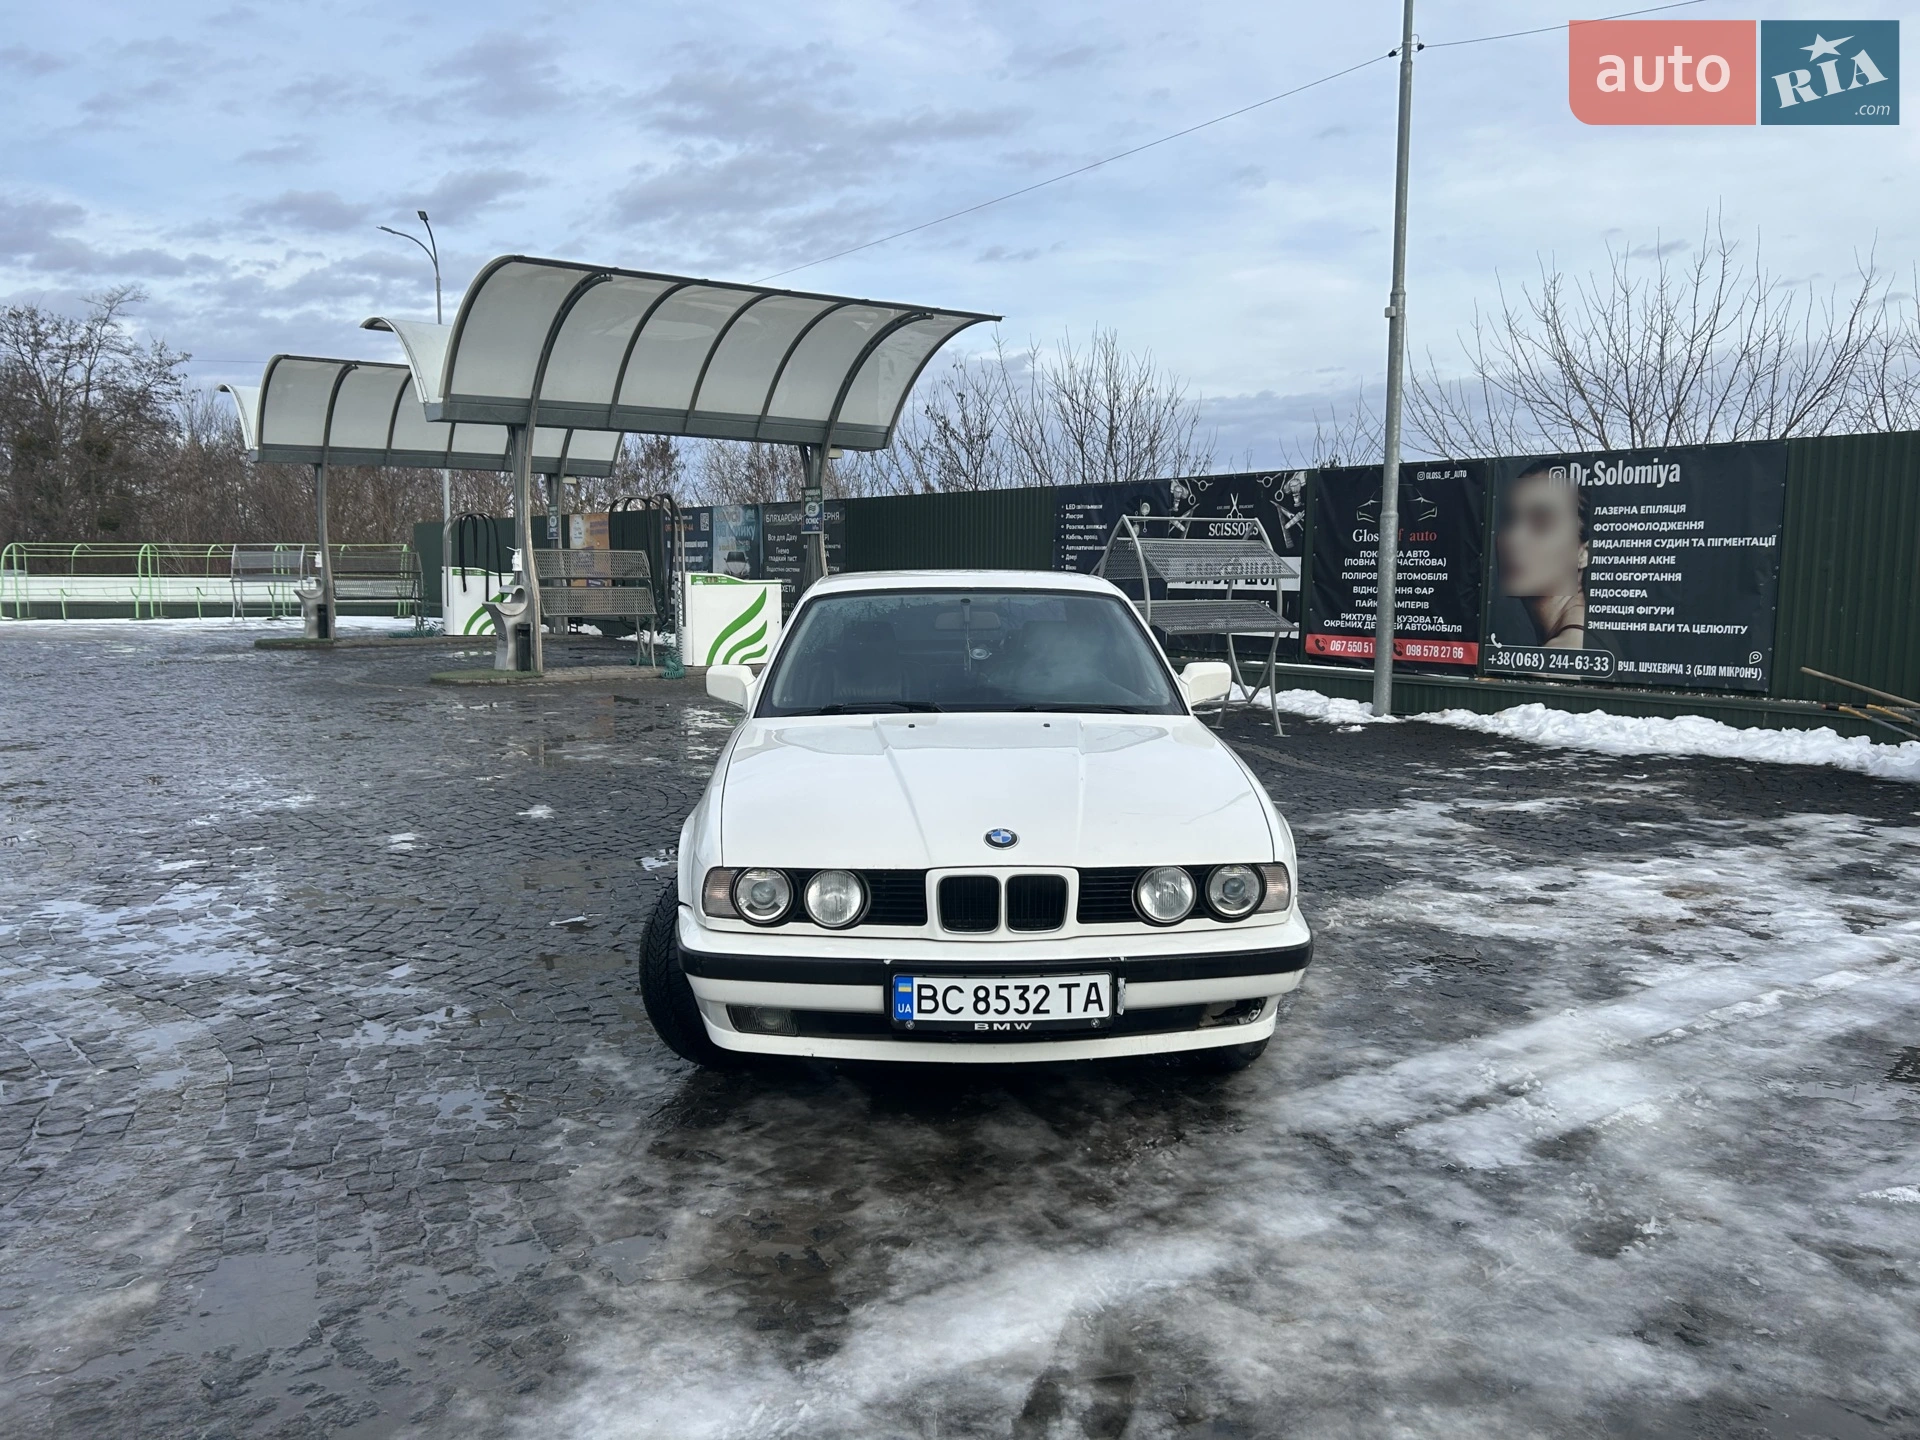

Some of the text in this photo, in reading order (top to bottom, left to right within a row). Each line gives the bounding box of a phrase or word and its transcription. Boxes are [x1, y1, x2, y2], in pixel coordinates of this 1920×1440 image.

[1569, 458, 1681, 488] Dr.Solomiya
[1594, 504, 1686, 516] ЛАЗЕРНА ЕПІЛЯЦІЯ
[1593, 520, 1705, 532] ФОТООМОЛОДЖЕННЯ
[1352, 529, 1380, 543] Glos
[1409, 530, 1438, 541] auto
[1592, 534, 1777, 549] ВИДАЛЕННЯ СУДИН ТА ПІГМЕНТАЦІЇ
[1405, 550, 1430, 558] АВТО
[1591, 555, 1676, 565] ЛІКУВАННЯ АКНЕ
[1344, 557, 1447, 567] (ПОВНА ЧАСТКОВА)
[1396, 572, 1449, 581] ВТОМОБІЛЯ
[1590, 572, 1682, 582] ВІСКІ ОБГОРТАННЯ
[1414, 586, 1435, 595] ФАР
[1590, 588, 1648, 599] ЕНДОСФЕРА
[1588, 604, 1675, 616] КОРЕКЦІЯ ФІГУРИ
[1396, 615, 1432, 624] КУЗОВА
[1432, 616, 1444, 624] ТА
[1323, 620, 1363, 629] ОКРЕМИХ
[1404, 623, 1463, 633] АВТОМОБІЛЯ
[1587, 620, 1749, 635] ЗМЕНШЕННЯ ВАГИ ТА ЦЕЛЮЛІТУ
[1329, 640, 1373, 653] 067 550 51
[1405, 644, 1465, 659] 098 578 27 66
[1488, 651, 1610, 671] +38(068) 244-63-33
[1617, 660, 1763, 681] ВУЛ. ШУХЕВИЧА 3 (БІЛЯ МІКРОНУ)
[916, 982, 1105, 1015] BC 8532 TA
[898, 1003, 911, 1013] UA
[974, 1022, 1033, 1032] BMW
